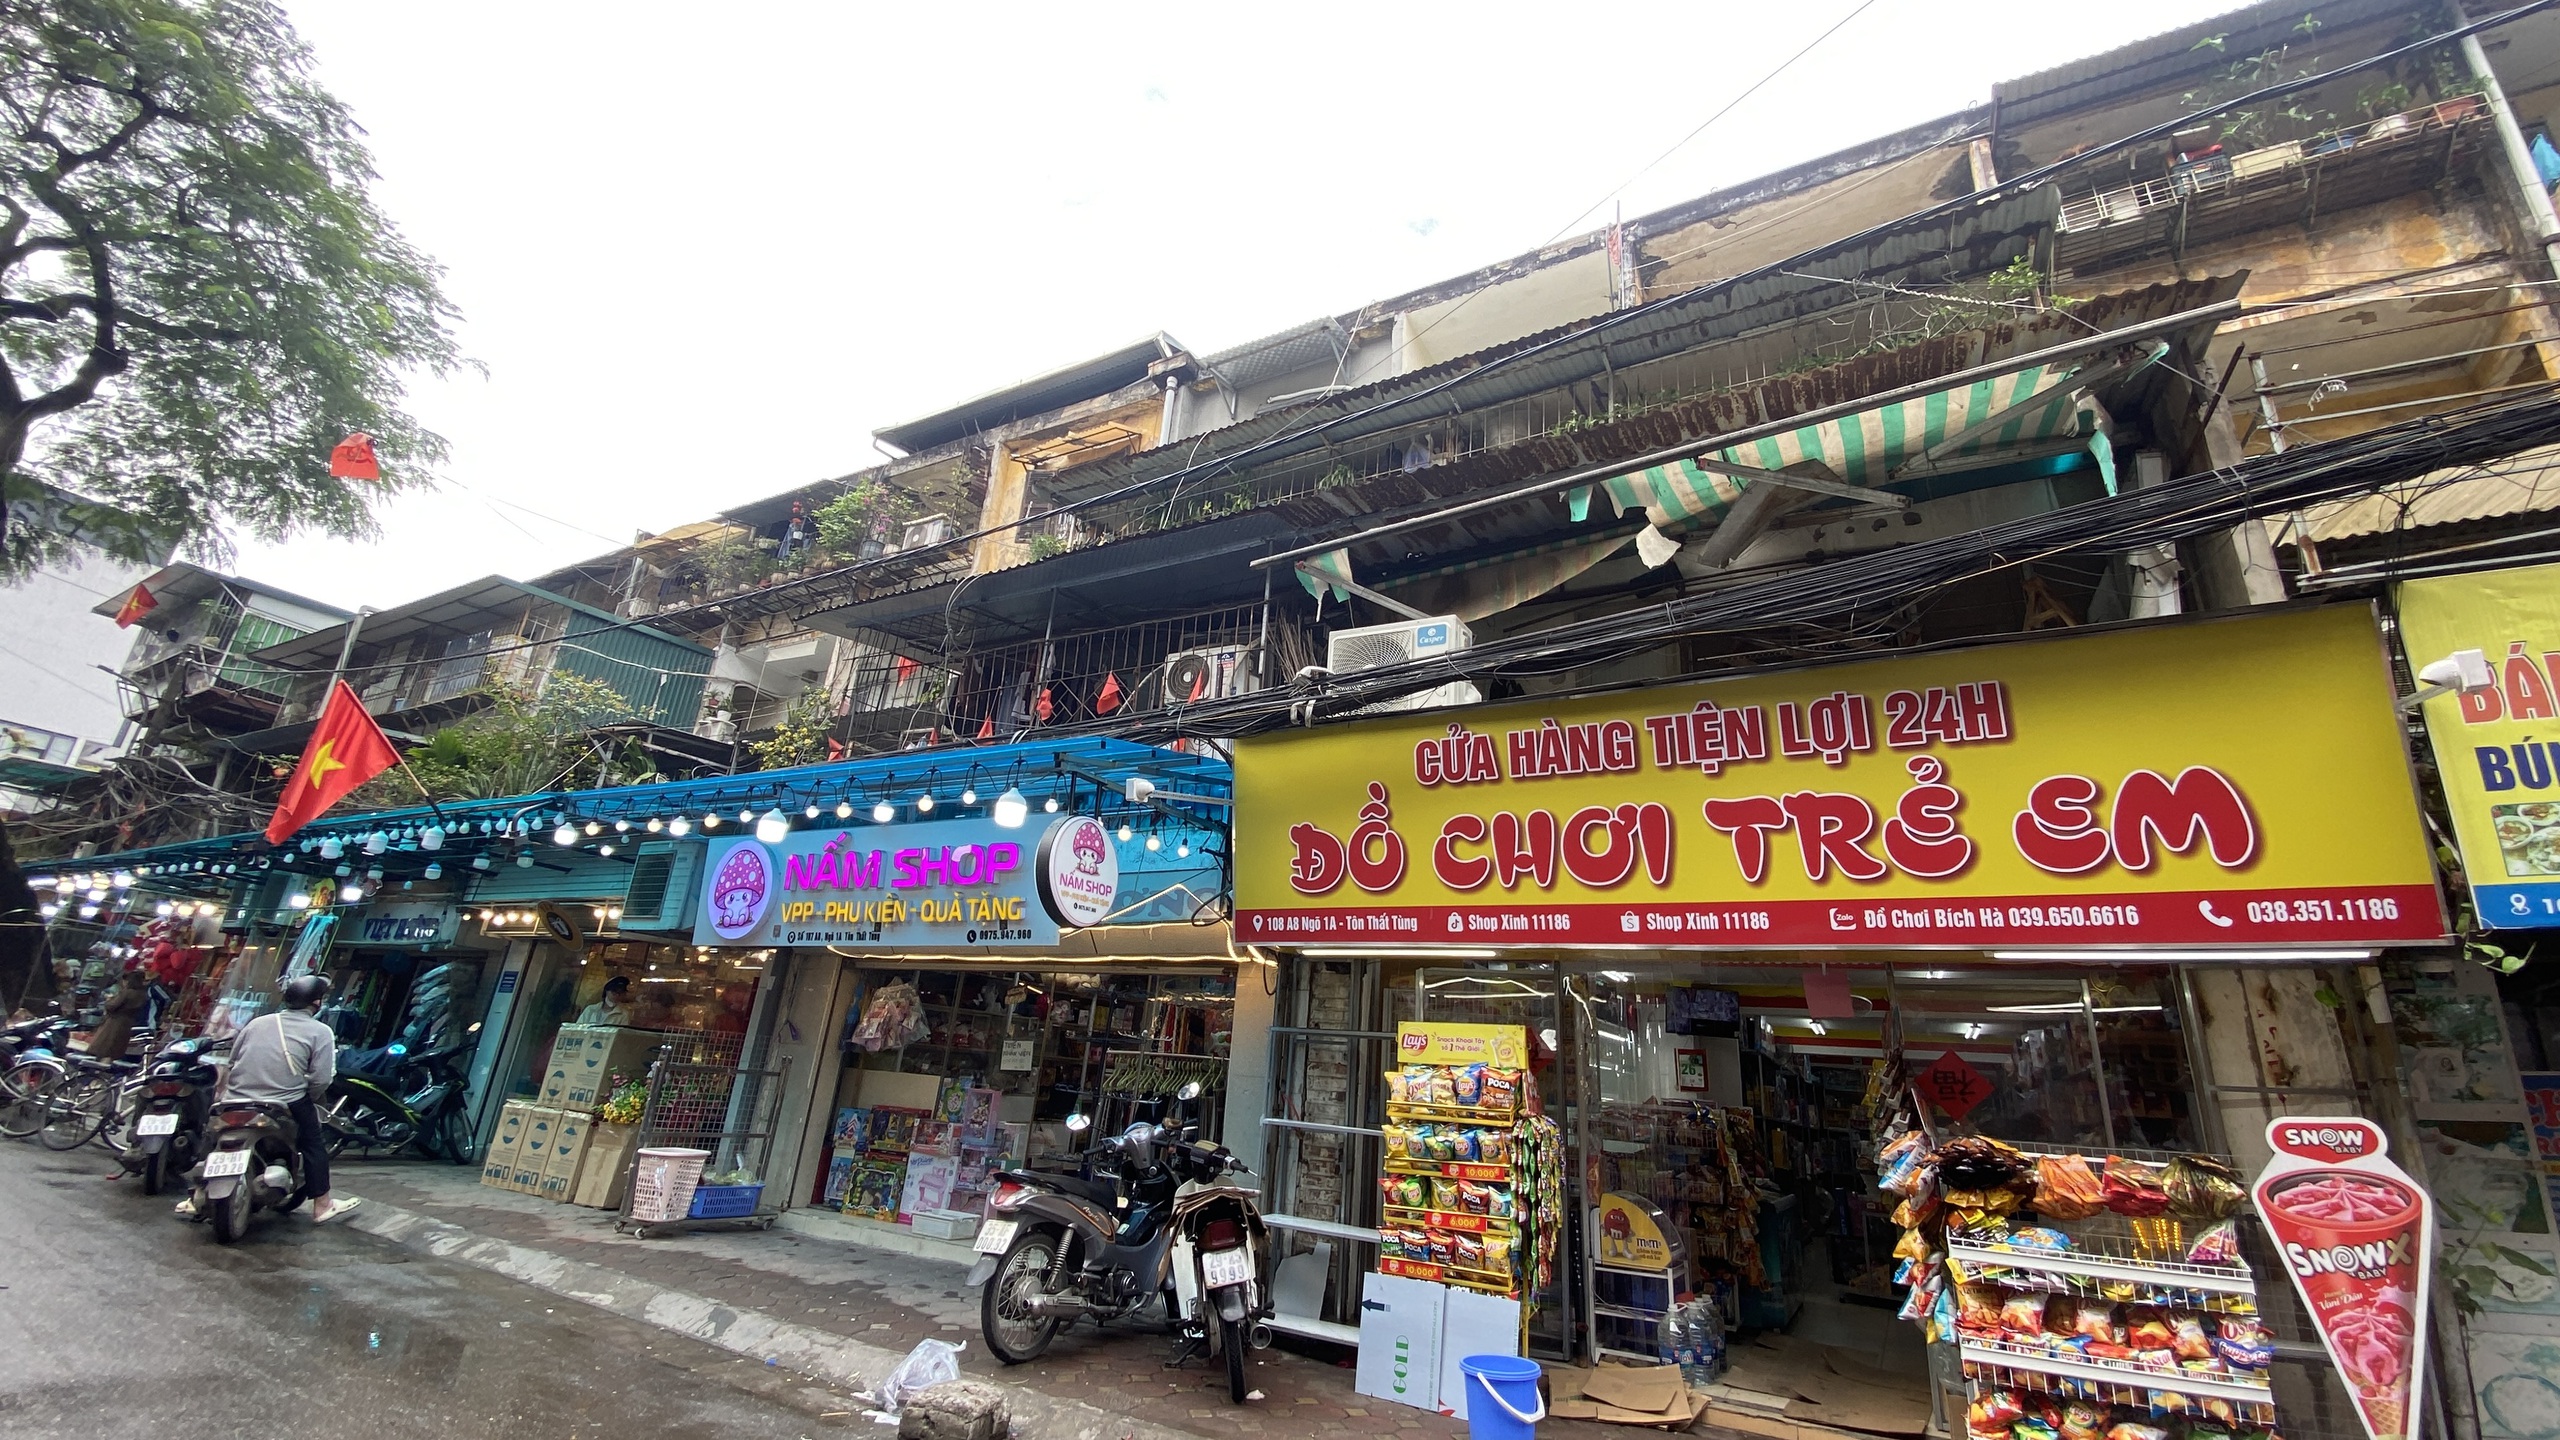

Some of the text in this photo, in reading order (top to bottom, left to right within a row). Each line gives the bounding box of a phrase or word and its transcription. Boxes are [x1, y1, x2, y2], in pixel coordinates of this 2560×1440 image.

[1420, 636, 1445, 644] Casper
[1414, 680, 2008, 785] CỬA HÀNG TIỆN LỢI 24H
[2474, 736, 2560, 792] BÚ
[1289, 755, 2254, 893] ĐỒ CHƠI TRẺ EM
[784, 831, 1021, 891] NẤM SHOP
[1059, 870, 1112, 897] NẤM SHOP
[782, 902, 814, 922] VPP
[1836, 913, 1854, 921] Zalo
[1864, 904, 2139, 928] Đồ Chơi Bích Hà 039.650.6616
[2247, 897, 2399, 925] 038.351.1186
[1267, 916, 1285, 931] 108
[1286, 916, 1300, 930] A8
[1301, 915, 1321, 932] Ngõ
[1323, 916, 1337, 930] 1A
[1346, 915, 1364, 930] Tôn
[1367, 912, 1389, 930] Thất
[1392, 915, 1418, 932] Tùng
[1468, 914, 1571, 932] Shop Xinh 11186
[1646, 911, 1770, 932] Shop Xinh 11186
[1450, 1043, 1454, 1051] 1
[1487, 1077, 1510, 1090] POCA
[2285, 1128, 2364, 1146] SNOW
[2335, 1146, 2362, 1154] BABY
[1463, 1191, 1481, 1204] POCA
[1382, 1235, 1399, 1244] POCA
[1404, 1242, 1421, 1253] POCA
[1430, 1242, 1446, 1253] POCA
[1458, 1247, 1476, 1260] POCA
[2358, 1268, 2387, 1280] BABY
[1392, 1334, 1410, 1394] GOLD
